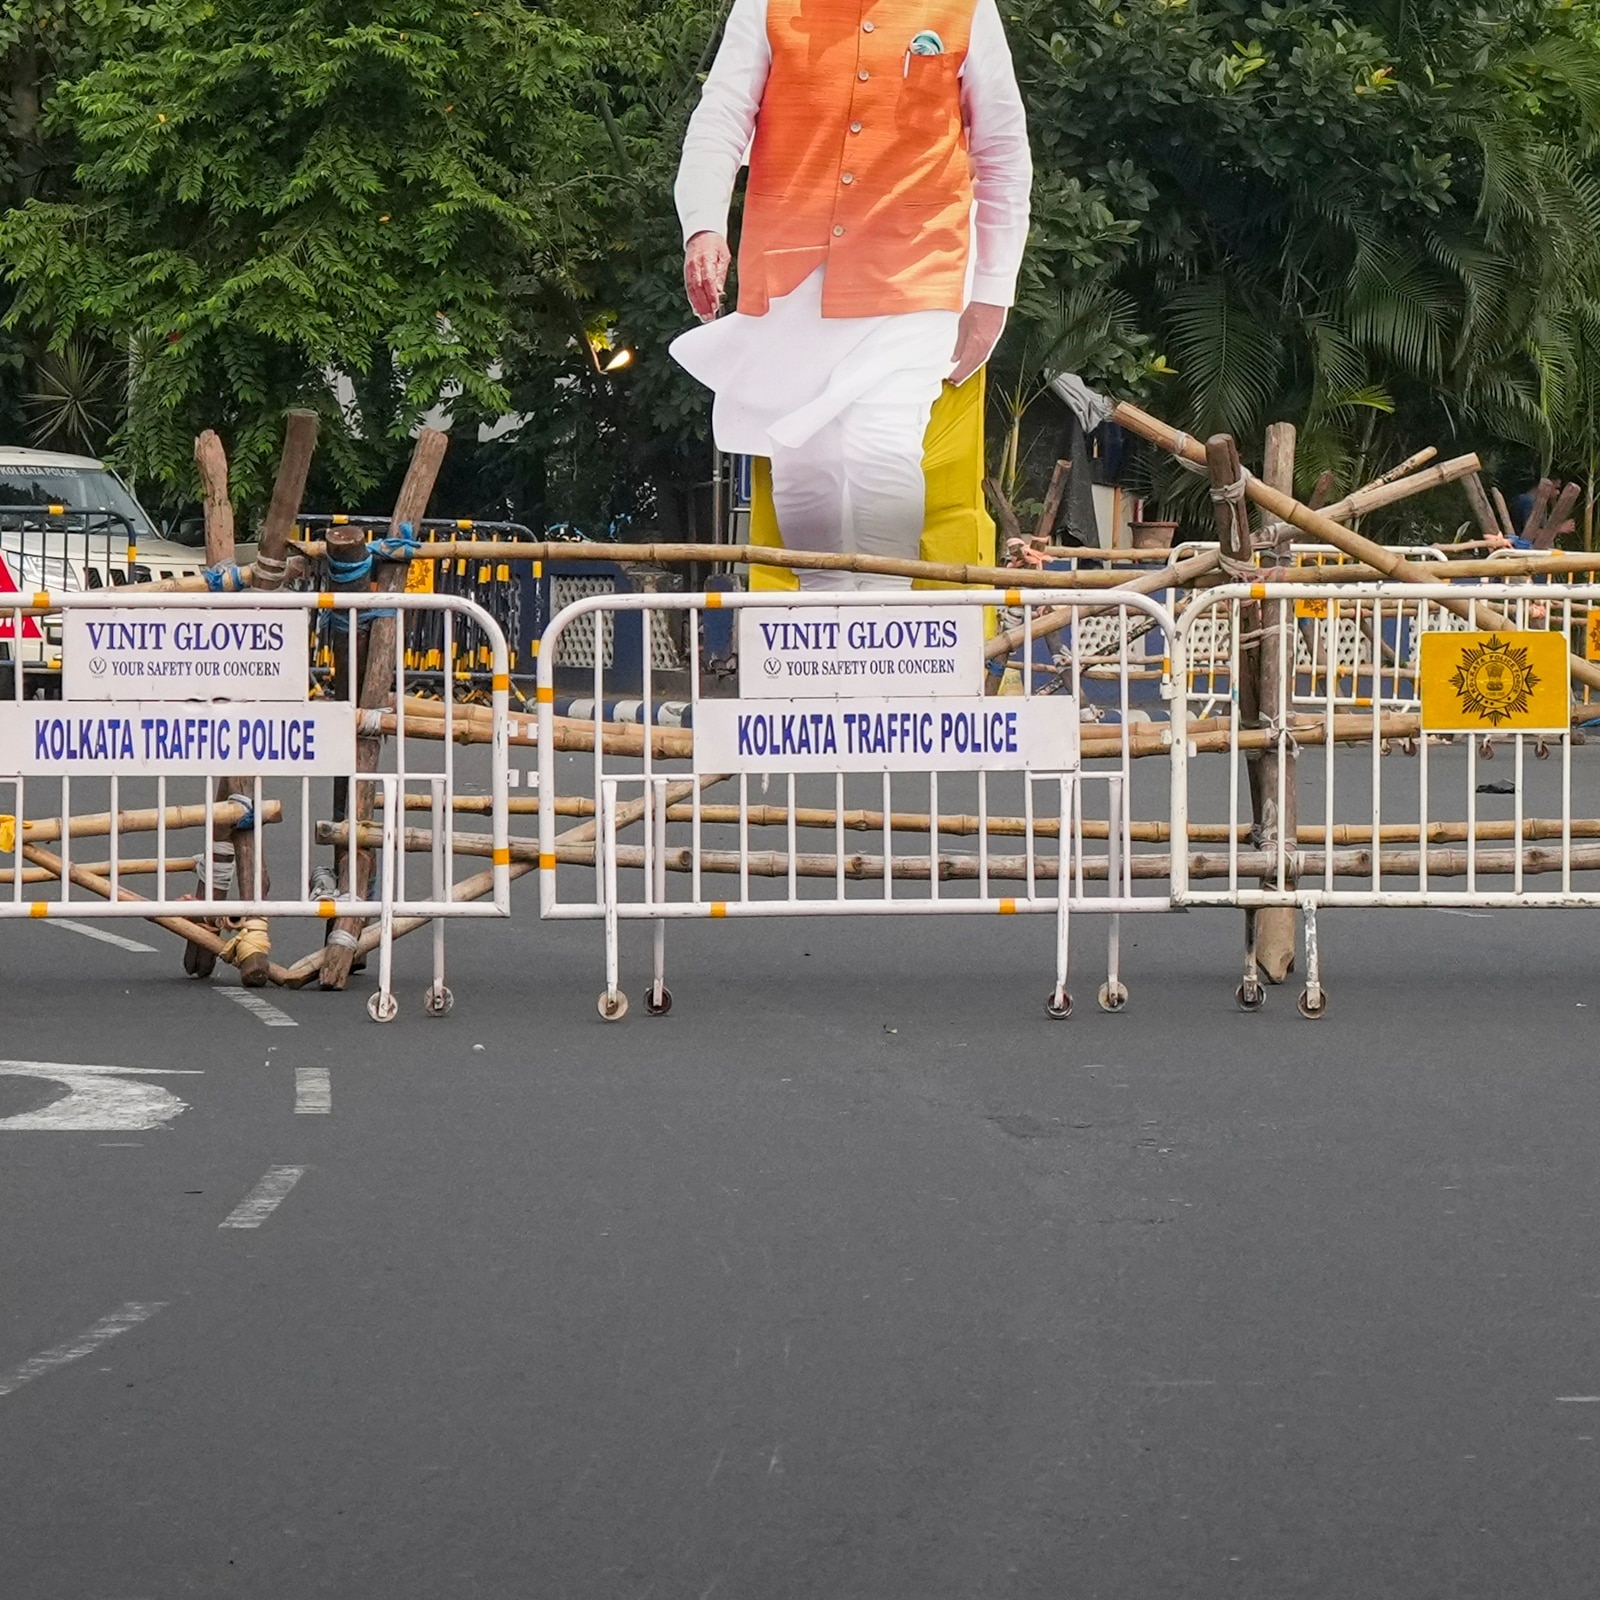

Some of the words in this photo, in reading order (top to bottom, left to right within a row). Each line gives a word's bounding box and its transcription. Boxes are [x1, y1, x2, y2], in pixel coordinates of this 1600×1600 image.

[86, 623, 166, 650] VINIT
[174, 623, 283, 651] GLOVES
[759, 623, 840, 650] VINIT
[848, 620, 957, 649] GLOVES
[112, 661, 144, 676] YOUR
[147, 661, 192, 676] SAFETY
[195, 661, 220, 676] OUR
[223, 661, 281, 676] CONCERN
[786, 661, 819, 676] YOUR
[822, 660, 867, 675] SAFETY
[870, 660, 895, 675] OUR
[898, 659, 955, 674] CONCERN
[35, 719, 134, 760] KOLKATA
[141, 719, 230, 760] TRAFFIC
[238, 719, 315, 760] POLICE
[738, 714, 837, 755] KOLKATA
[844, 713, 932, 754] TRAFFIC
[941, 712, 1018, 753] POLICE
